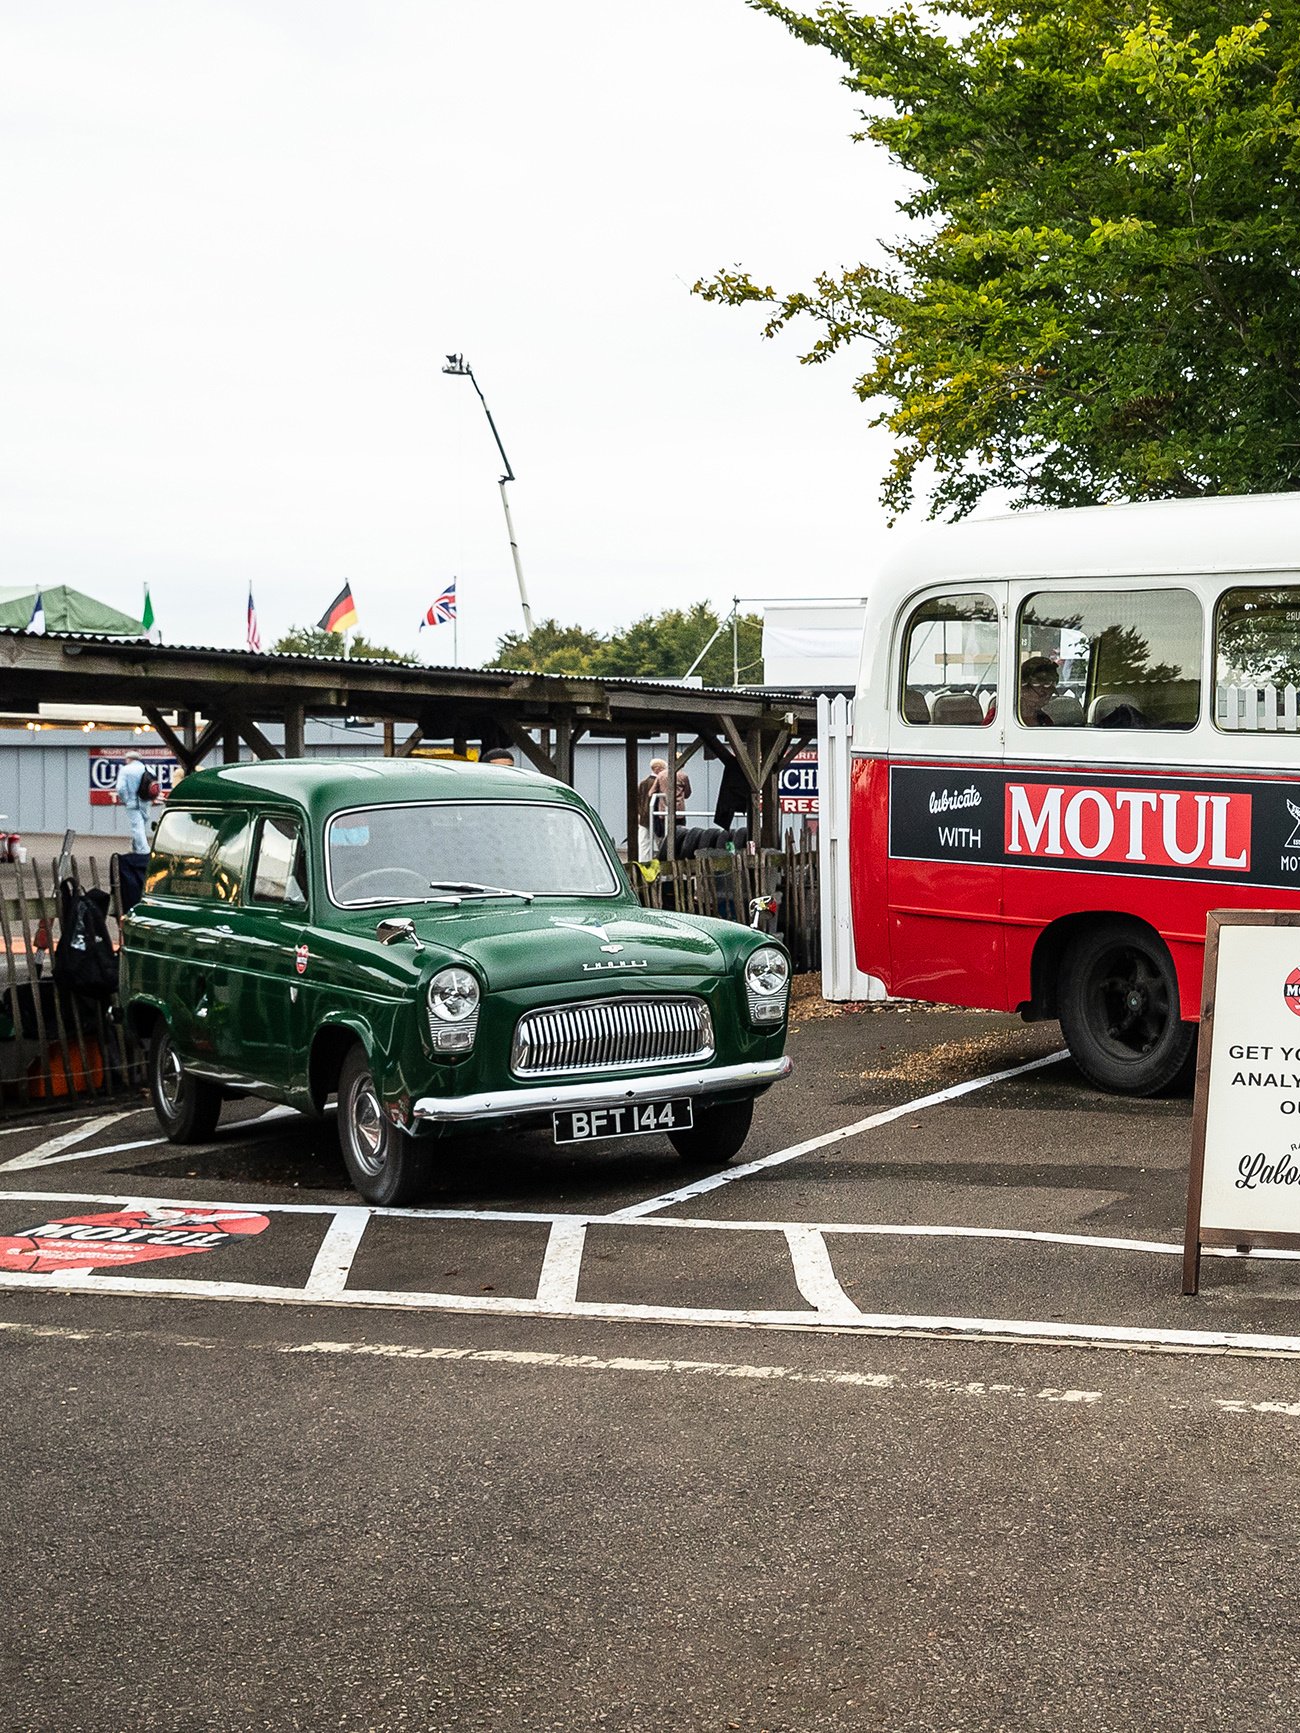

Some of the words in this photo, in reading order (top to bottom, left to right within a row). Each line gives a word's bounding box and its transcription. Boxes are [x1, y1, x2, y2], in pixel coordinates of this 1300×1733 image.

[929, 785, 982, 814] lubricate
[938, 826, 982, 849] WITH
[1008, 786, 1247, 868] MOTUL
[1229, 1045, 1273, 1060] GET
[572, 1108, 626, 1138] BFT
[633, 1102, 675, 1131] 144
[14, 1223, 230, 1247] MOTUL
